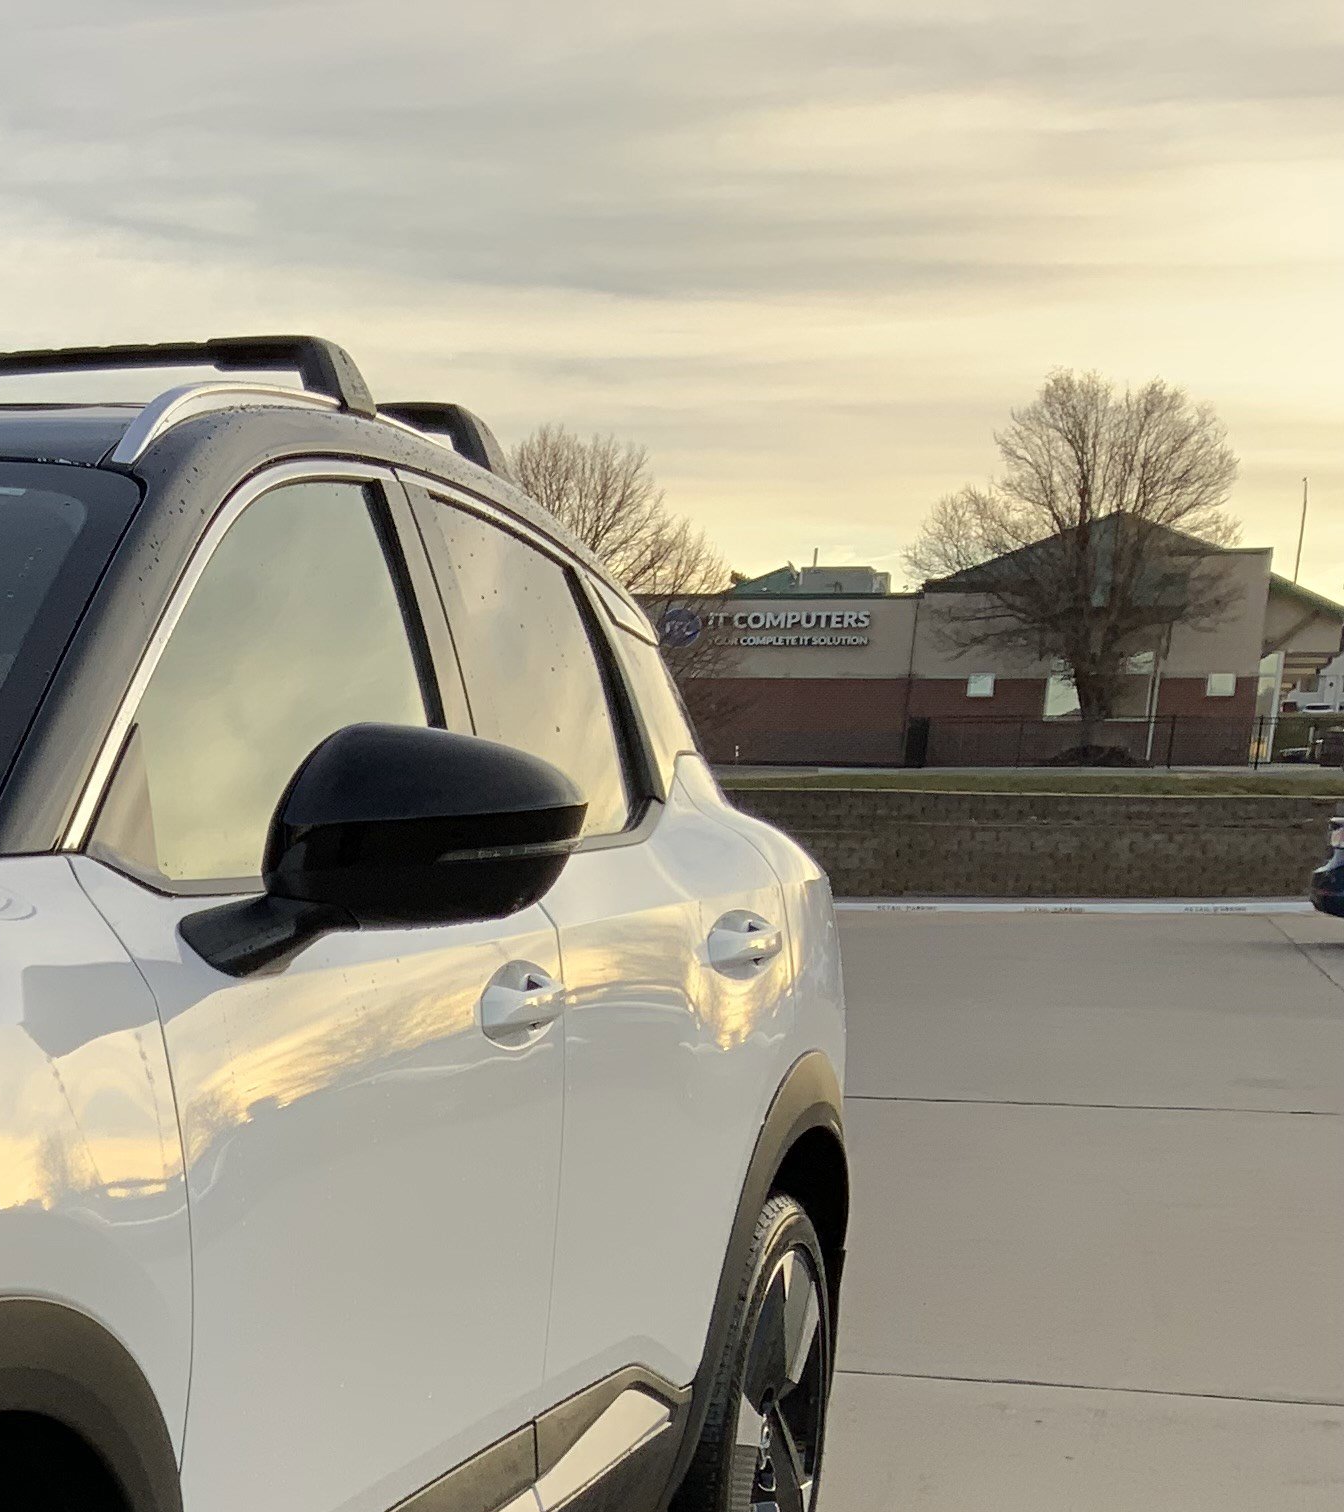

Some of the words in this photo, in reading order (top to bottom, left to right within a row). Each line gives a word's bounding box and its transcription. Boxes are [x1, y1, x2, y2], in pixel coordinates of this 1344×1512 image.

[734, 610, 871, 629] COMPUTERS
[740, 636, 799, 646] COMPLETE
[812, 635, 868, 646] SOLUTION
